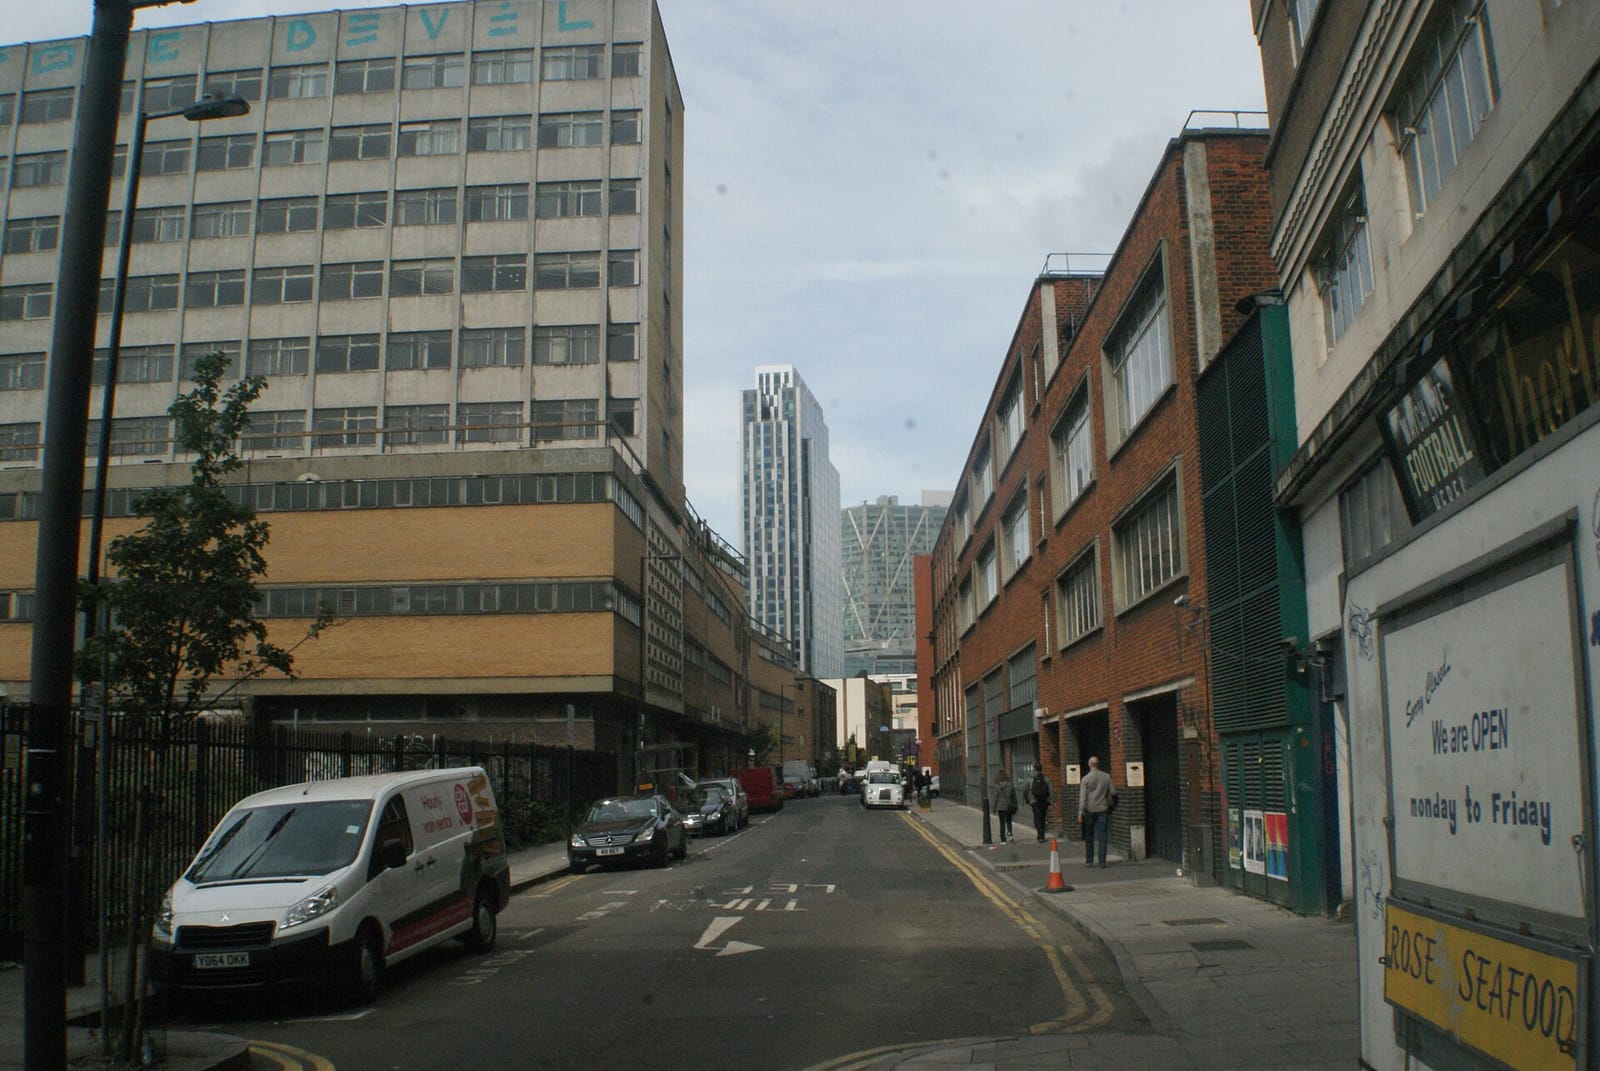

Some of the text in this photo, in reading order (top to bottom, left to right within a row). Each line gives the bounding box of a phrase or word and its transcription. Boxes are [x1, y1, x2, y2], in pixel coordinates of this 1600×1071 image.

[0, 46, 76, 80] O
[286, 1, 595, 53] DEVEL
[1406, 414, 1474, 497] FOOTBALL
[1432, 708, 1508, 755] We are OPEN
[1465, 785, 1481, 823] to
[1492, 791, 1551, 845] Friday
[1389, 925, 1576, 1047] ROSE SEAFOOD
